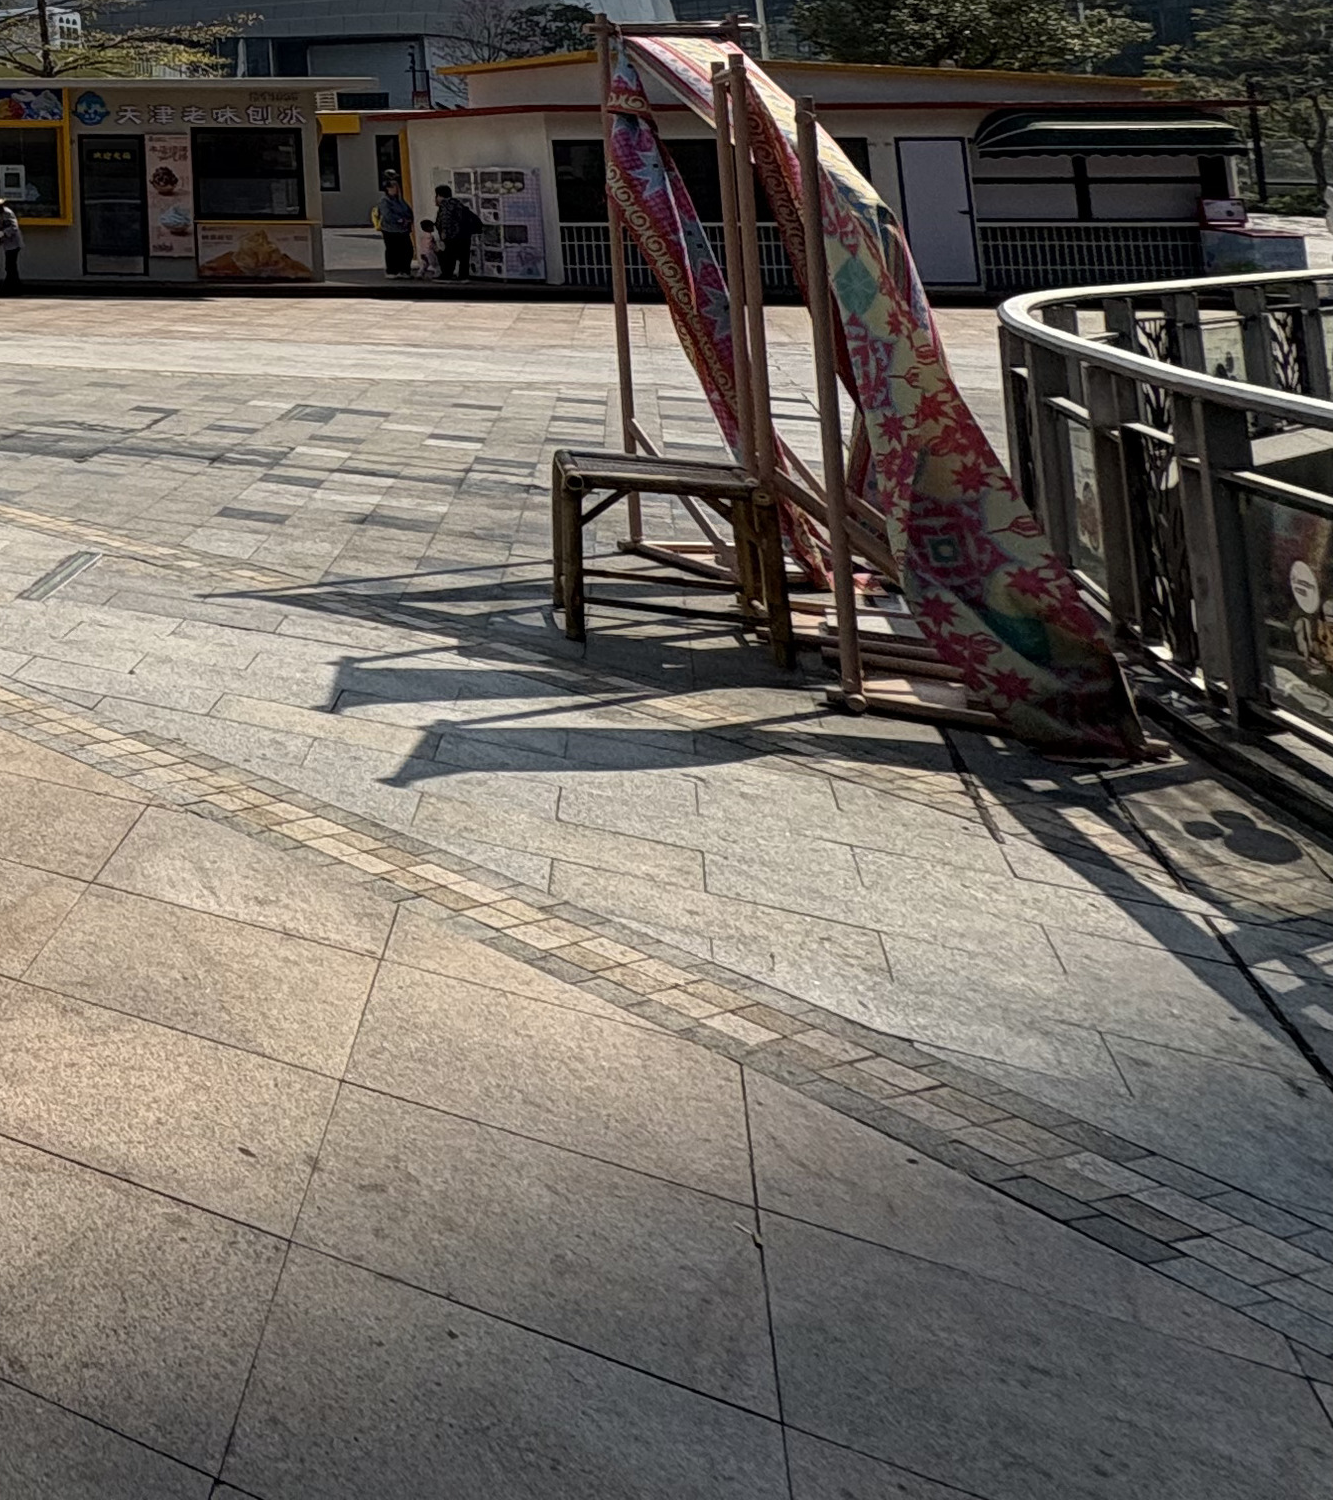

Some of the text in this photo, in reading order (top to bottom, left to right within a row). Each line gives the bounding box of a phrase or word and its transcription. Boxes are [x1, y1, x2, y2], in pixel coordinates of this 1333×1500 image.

[116, 105, 307, 125] 天津老味刨冰
